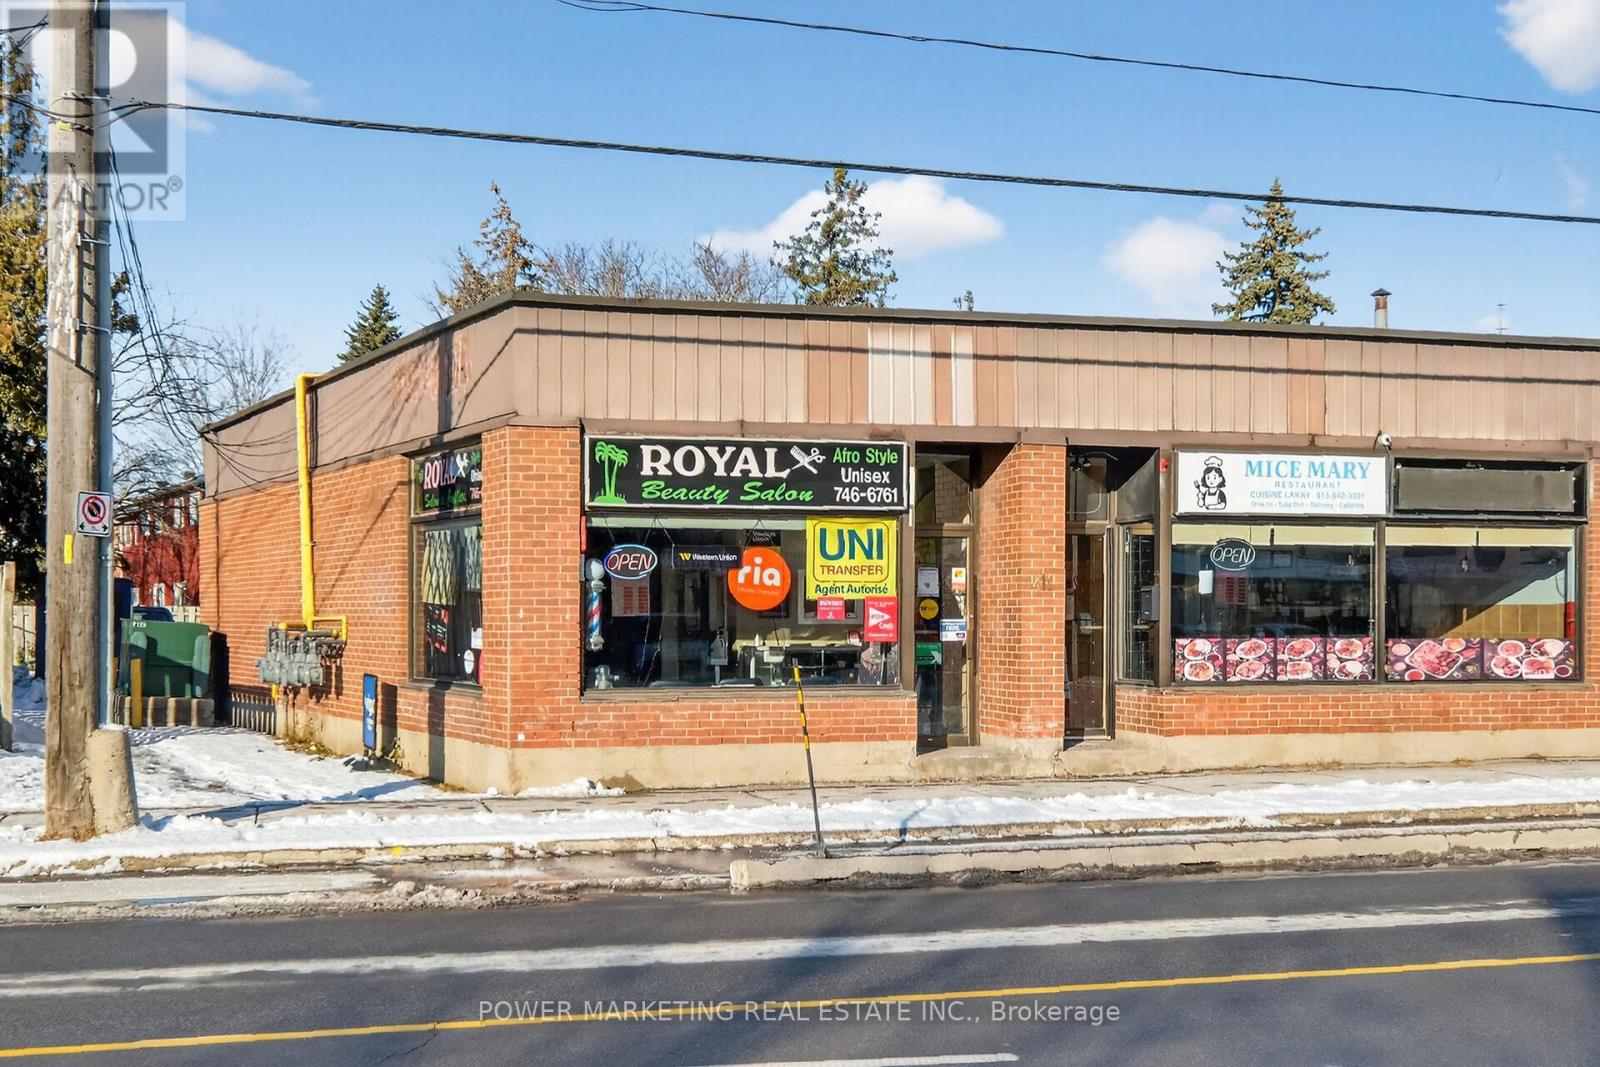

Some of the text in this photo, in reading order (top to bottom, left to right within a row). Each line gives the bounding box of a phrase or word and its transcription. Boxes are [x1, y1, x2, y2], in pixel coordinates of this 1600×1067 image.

[640, 444, 790, 478] ROYAL
[832, 447, 898, 467] Afro Style
[842, 468, 890, 484] Unisex
[1244, 460, 1371, 480] MICE MARY
[641, 480, 814, 504] Beauty Salon
[834, 486, 898, 504] 746-6761
[820, 528, 884, 561] UNI
[608, 554, 652, 571] OPEN
[718, 552, 738, 561] Union
[1212, 547, 1252, 563] OPEN
[738, 556, 782, 586] ria
[820, 564, 884, 575] TRANSFER
[815, 583, 888, 596] Agent Autorisé
